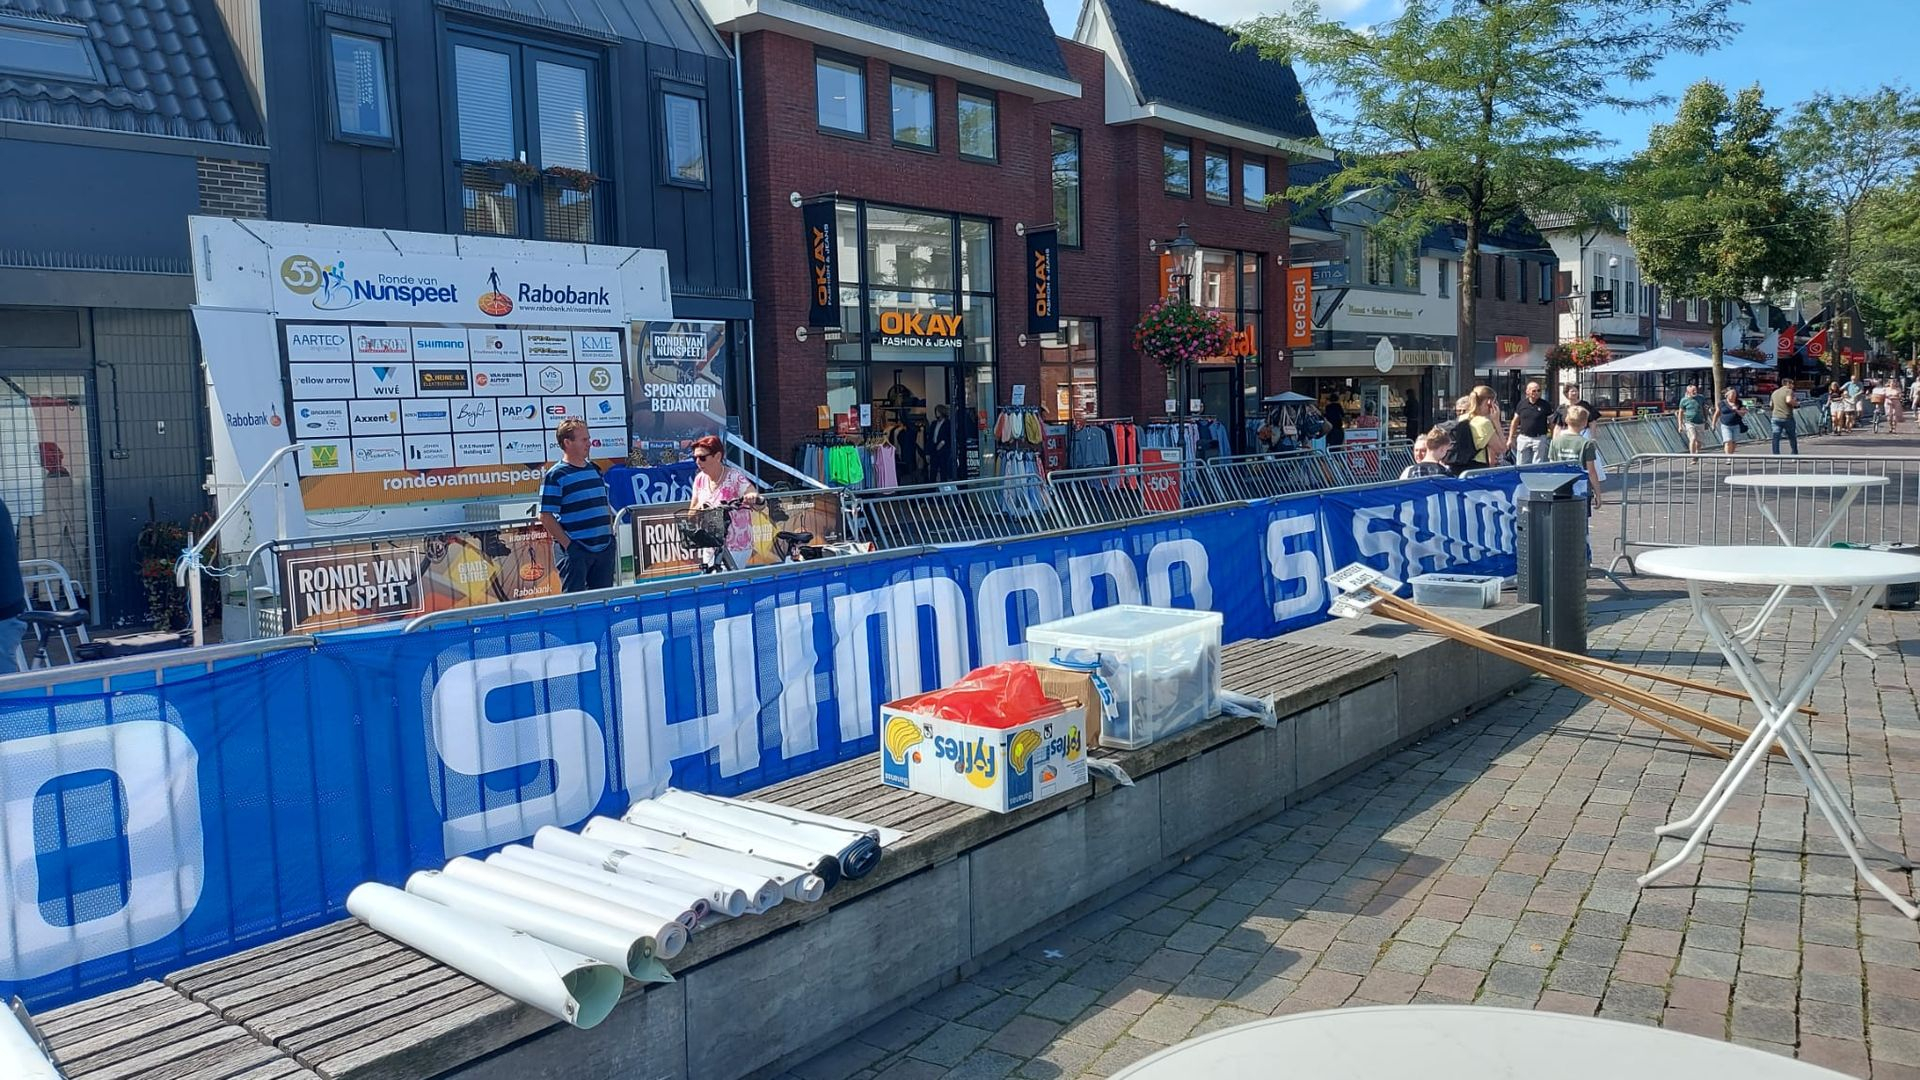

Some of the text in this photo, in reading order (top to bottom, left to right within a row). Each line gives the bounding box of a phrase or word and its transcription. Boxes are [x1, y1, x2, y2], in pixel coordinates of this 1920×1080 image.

[813, 226, 827, 306] OKAY
[378, 273, 438, 286] Ronde van
[1034, 250, 1047, 317] OKAY
[354, 279, 458, 306] Nunspeet
[518, 283, 610, 306] Rabobank
[1293, 278, 1306, 337] terStal
[880, 311, 962, 336] OKAY
[417, 340, 464, 349] SHIMANO
[581, 336, 613, 349] KME
[654, 336, 703, 347] RONDE VAN
[882, 337, 963, 348] FASHION & JEANS
[656, 346, 701, 357] NUNSPEET
[326, 376, 350, 384] arrow
[374, 385, 400, 395] WIVÉ
[644, 383, 716, 398] SPONSOREN
[502, 406, 523, 416] PAP
[651, 398, 710, 413] BEDANKT!
[226, 412, 269, 427] Rabobank
[354, 413, 389, 423] Axxent
[298, 557, 413, 594] RONDE VAN
[306, 579, 409, 617] NUNSPEET
[513, 584, 552, 598] Rabobank
[432, 537, 1213, 858] SHIMANO
[934, 734, 996, 779] Fyffes
